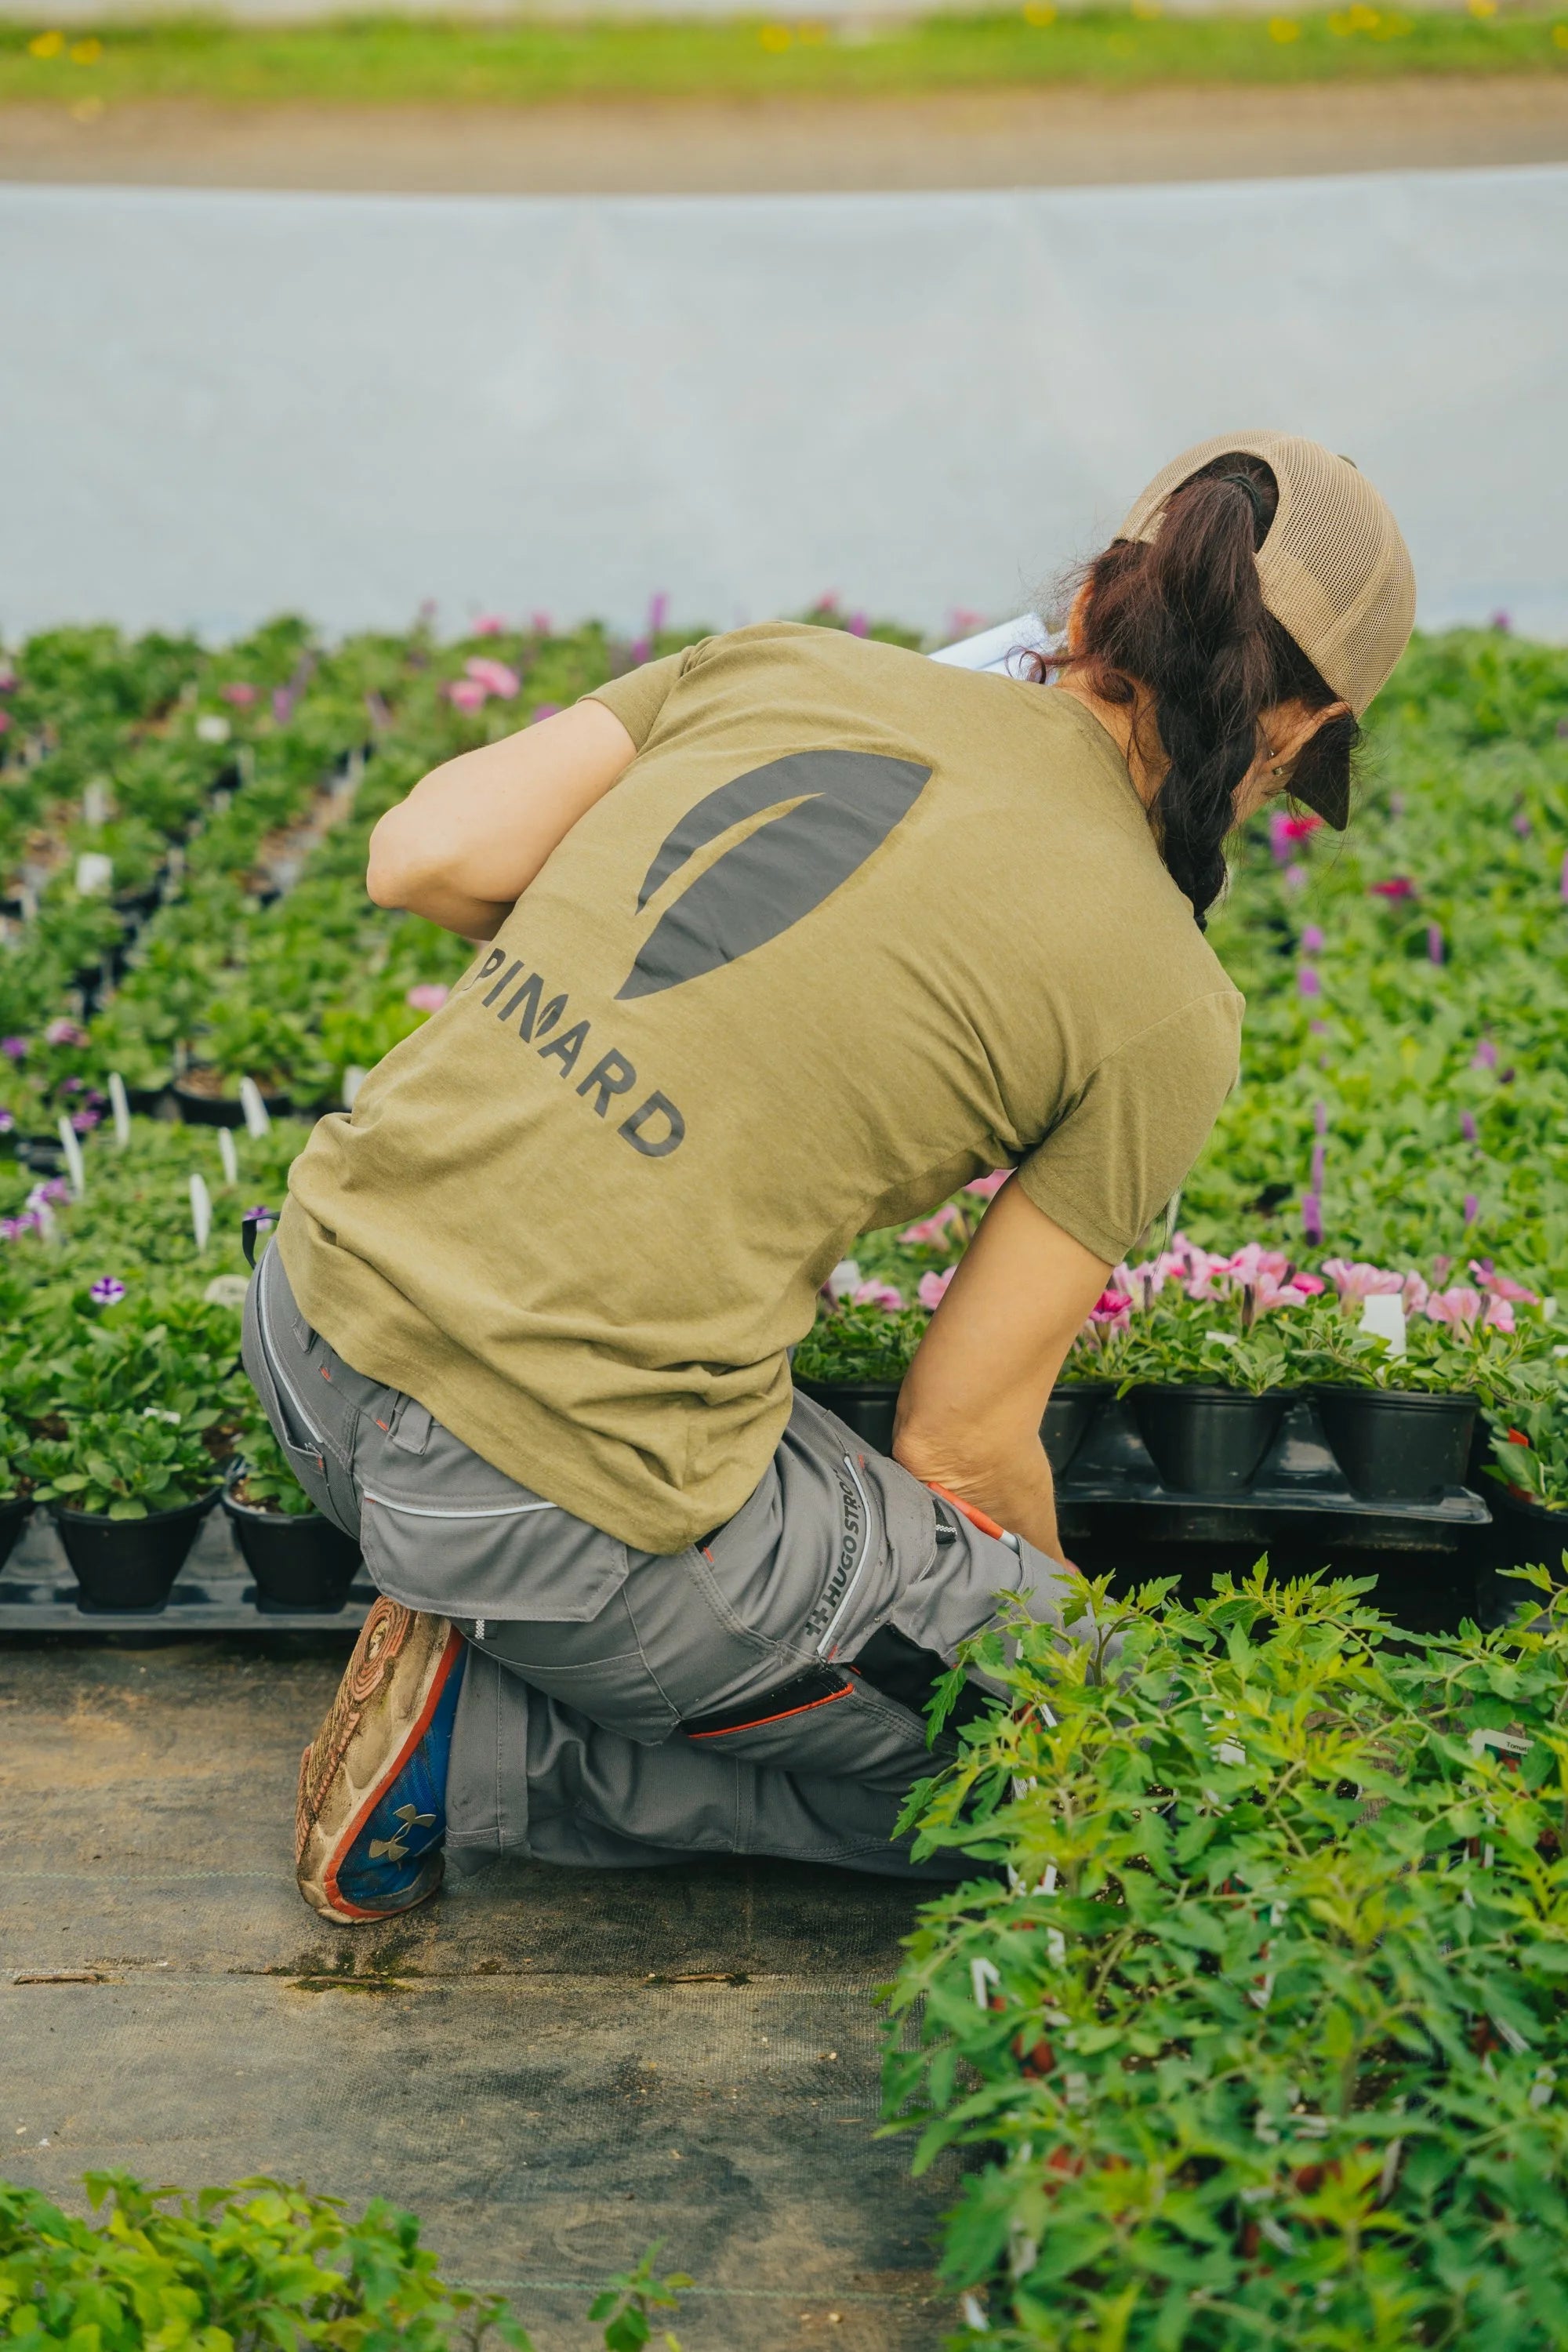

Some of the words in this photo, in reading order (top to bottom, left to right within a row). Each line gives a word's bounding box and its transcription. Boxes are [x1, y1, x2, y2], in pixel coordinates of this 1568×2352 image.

[466, 947, 685, 1158] PINARD
[822, 1535, 857, 1608] HUGO
[1506, 1741, 1530, 1752] Tomat
